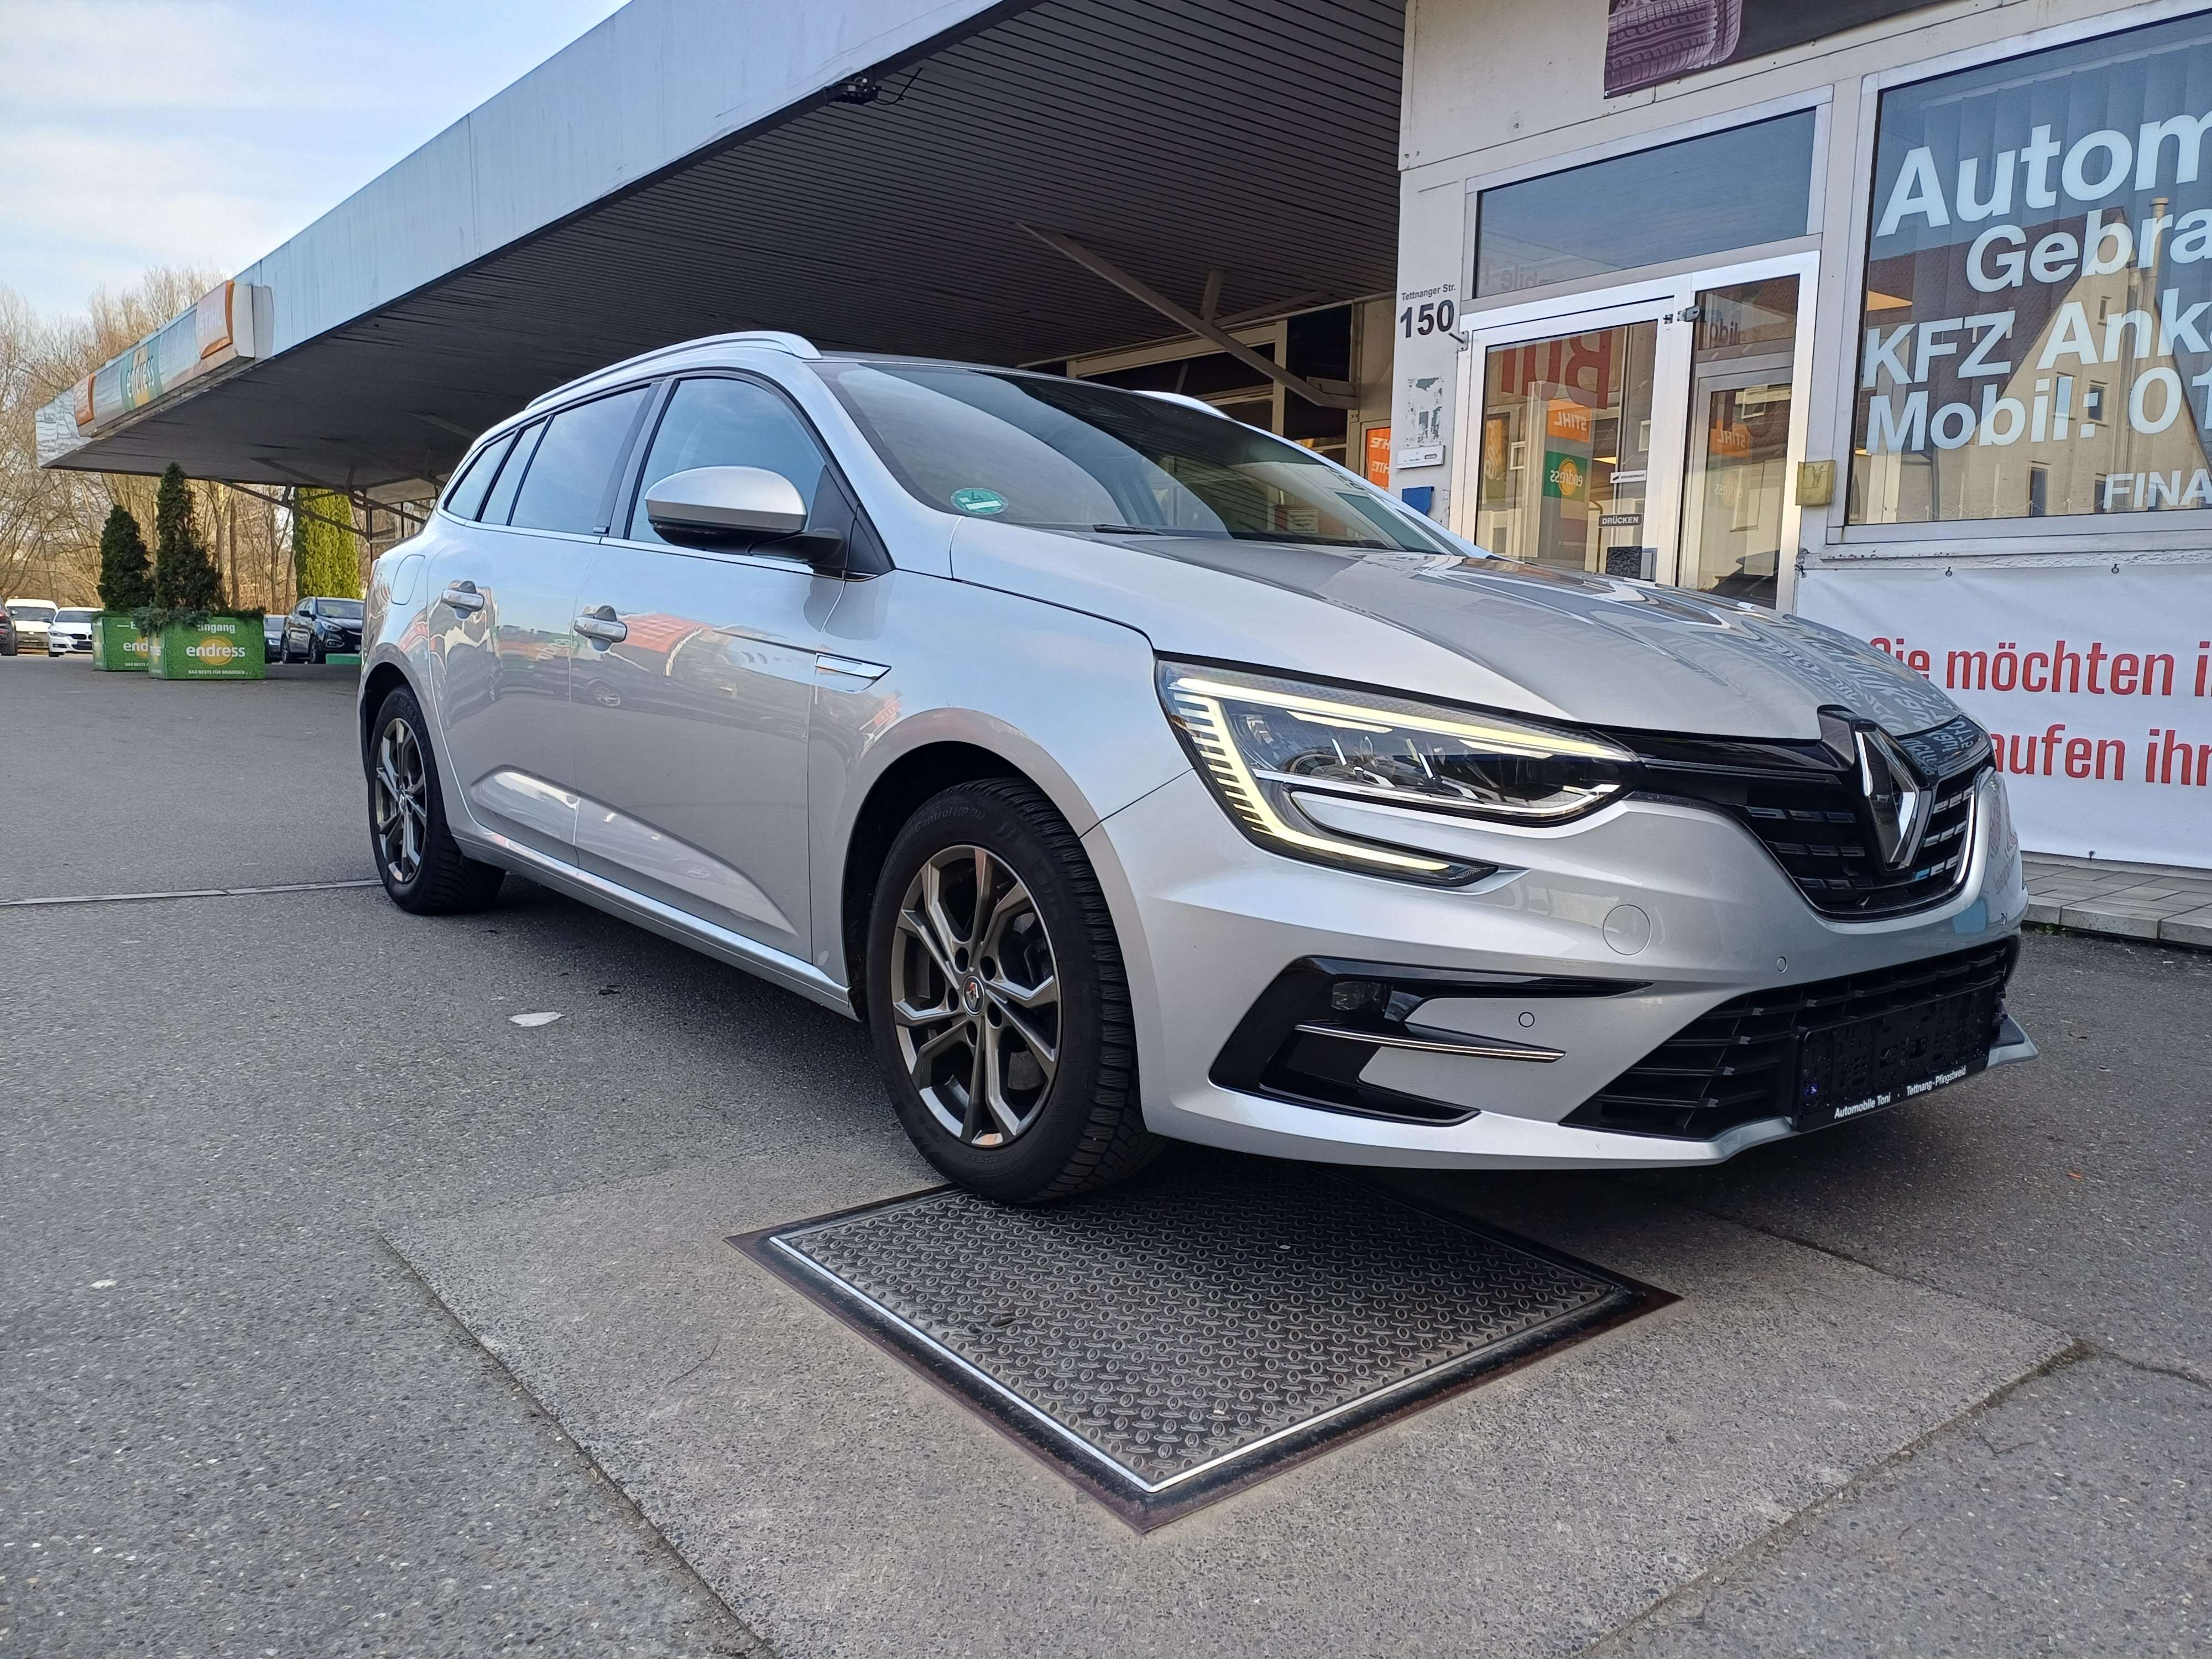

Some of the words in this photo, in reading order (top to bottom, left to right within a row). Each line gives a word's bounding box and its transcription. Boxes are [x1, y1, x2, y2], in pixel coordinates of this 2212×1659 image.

[1401, 288, 1441, 300] Tettnanger
[1443, 284, 1455, 292] Str.
[1400, 300, 1454, 338] 150
[1862, 310, 2016, 388] KFZ
[2035, 288, 2212, 370] Ank
[1866, 377, 2099, 454] Mobil:
[2103, 468, 2212, 509] FINA
[1602, 515, 1639, 525] DRÜCKEN
[186, 643, 246, 657] endress
[1946, 640, 2174, 696] möchten
[1834, 1098, 1875, 1119] Automobile
[1876, 1092, 1891, 1106] Toni
